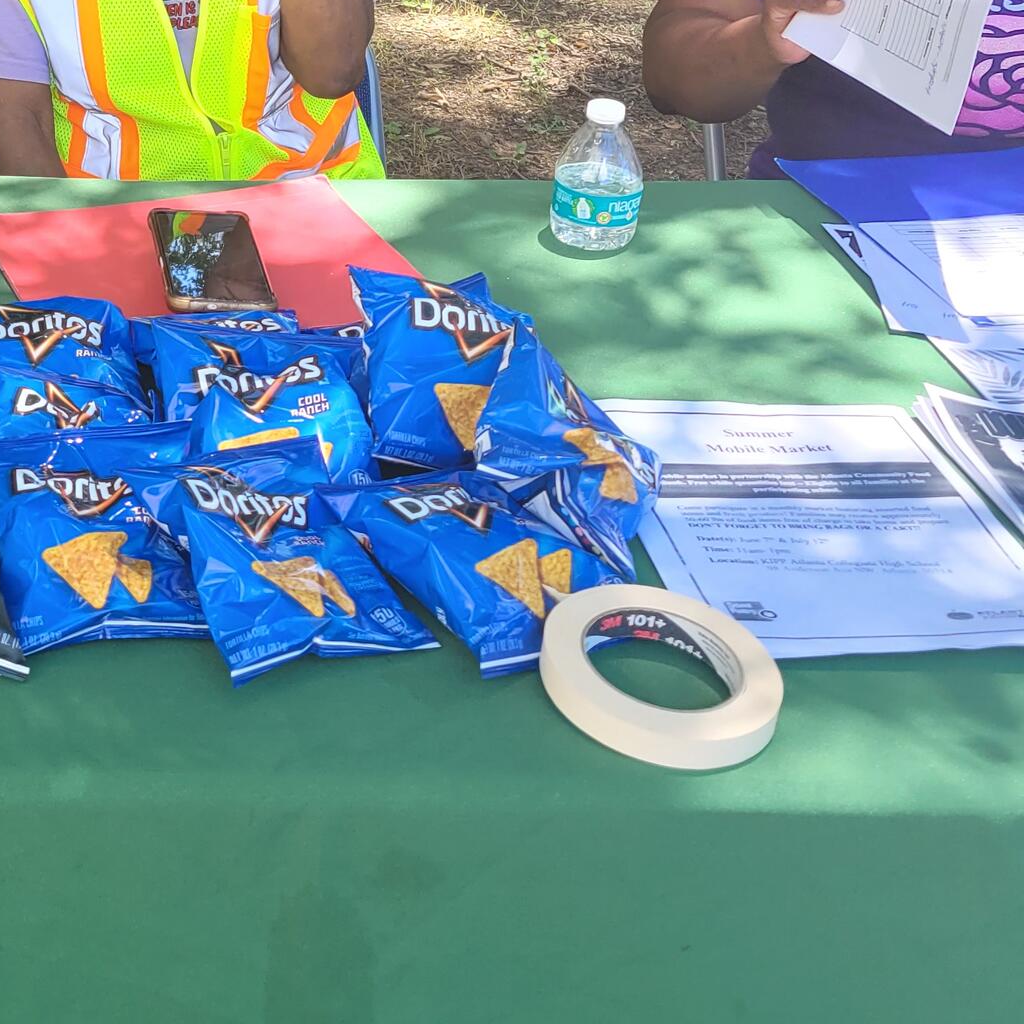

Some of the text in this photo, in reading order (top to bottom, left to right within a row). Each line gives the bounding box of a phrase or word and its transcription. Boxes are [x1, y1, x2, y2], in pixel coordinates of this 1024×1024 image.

[297, 392, 328, 407] COOL
[291, 402, 330, 417] RANCH
[723, 428, 794, 438] Summer
[706, 443, 833, 454] Mobile Market
[15, 467, 133, 502] Dorito
[186, 478, 306, 526] Doritos
[626, 614, 667, 629] 101+
